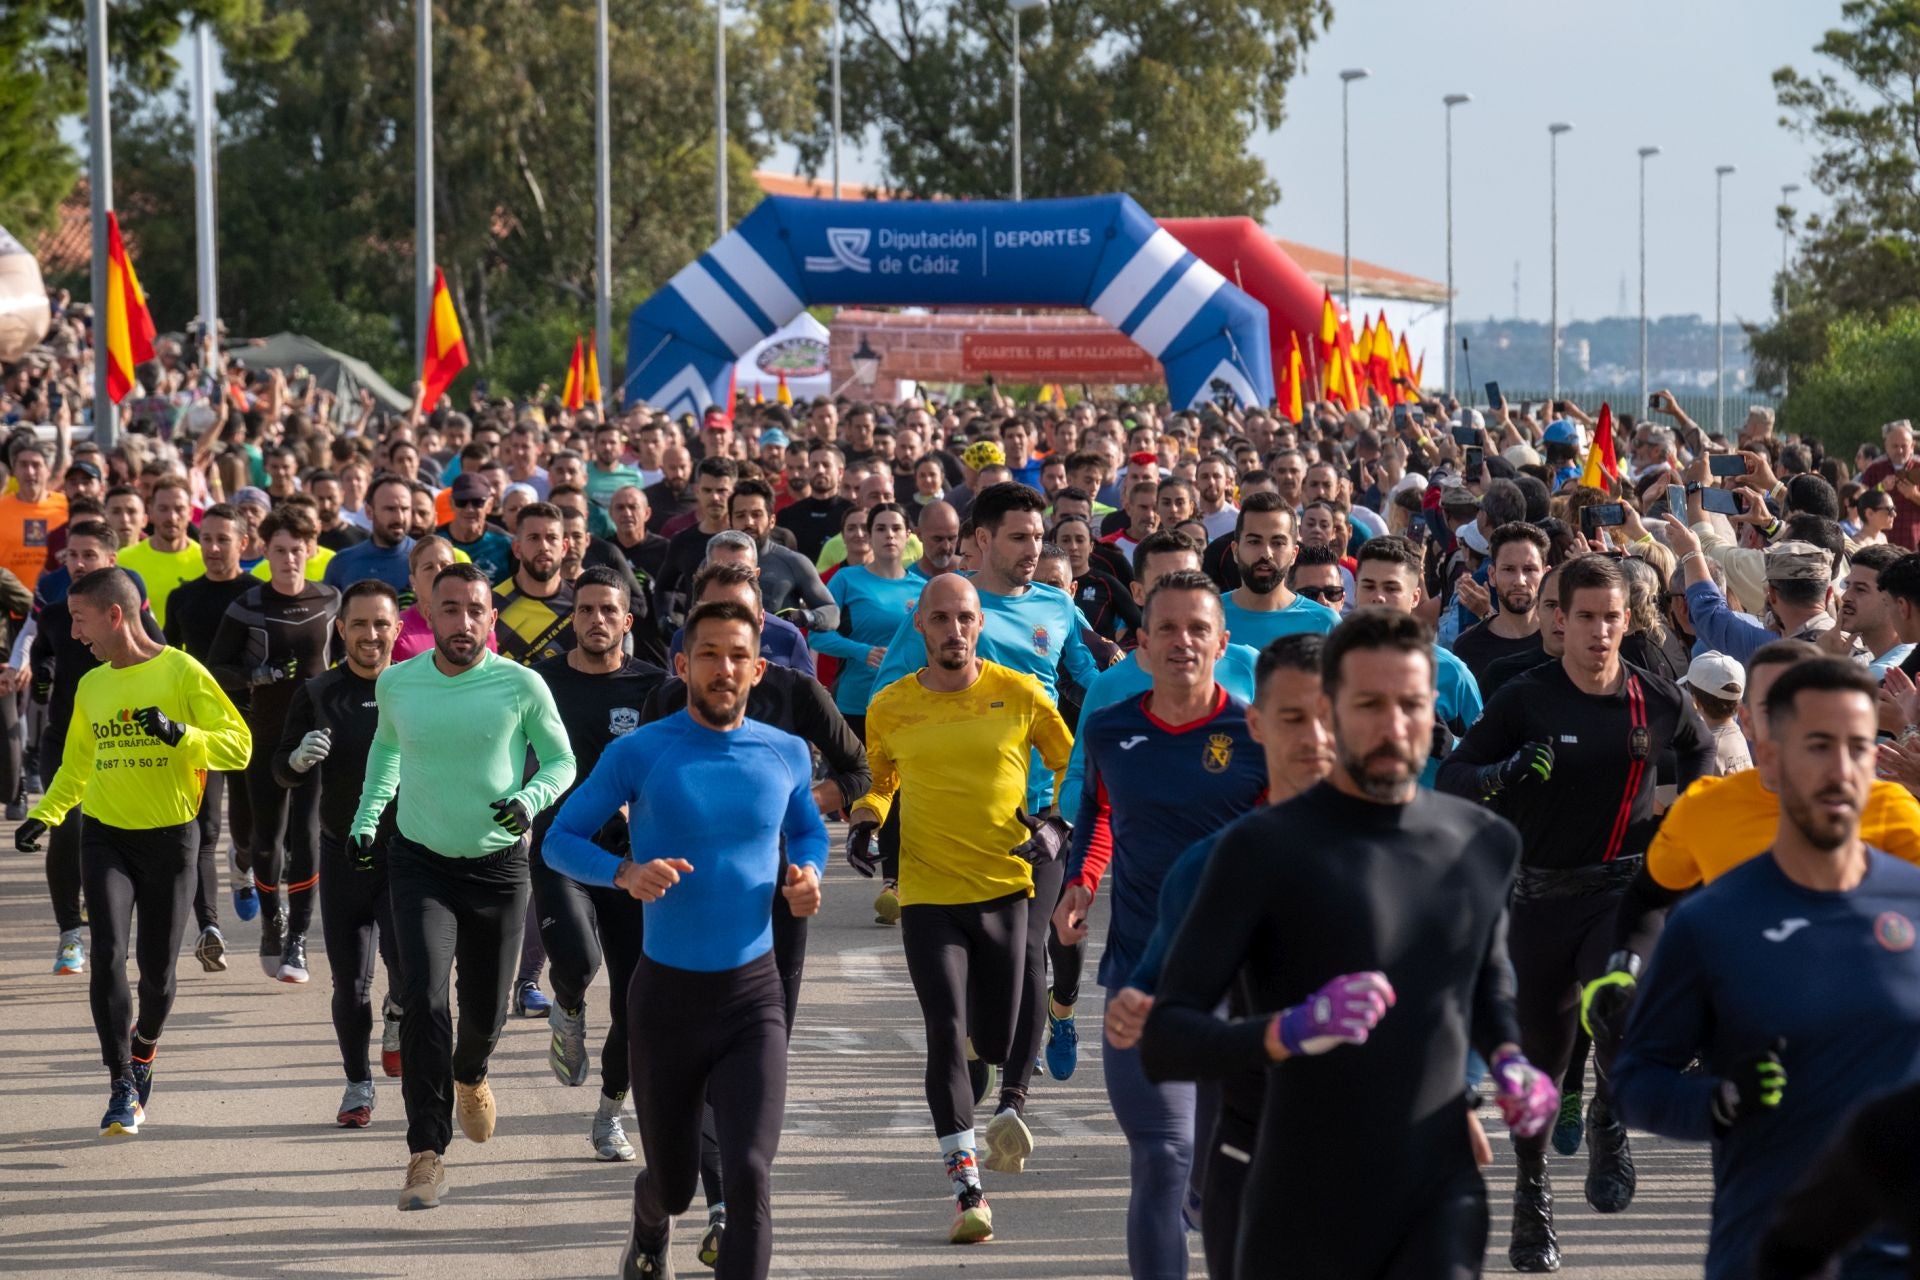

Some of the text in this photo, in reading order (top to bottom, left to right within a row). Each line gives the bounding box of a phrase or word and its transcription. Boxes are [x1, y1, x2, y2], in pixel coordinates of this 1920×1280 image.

[878, 228, 977, 251] Diputación
[994, 228, 1090, 247] DEPORTES
[878, 254, 960, 274] de Cádiz
[1036, 346, 1055, 359] DE
[92, 718, 141, 740] Rober
[118, 738, 161, 748] GRÁFICAS
[103, 757, 169, 769] 687 19 50 27
